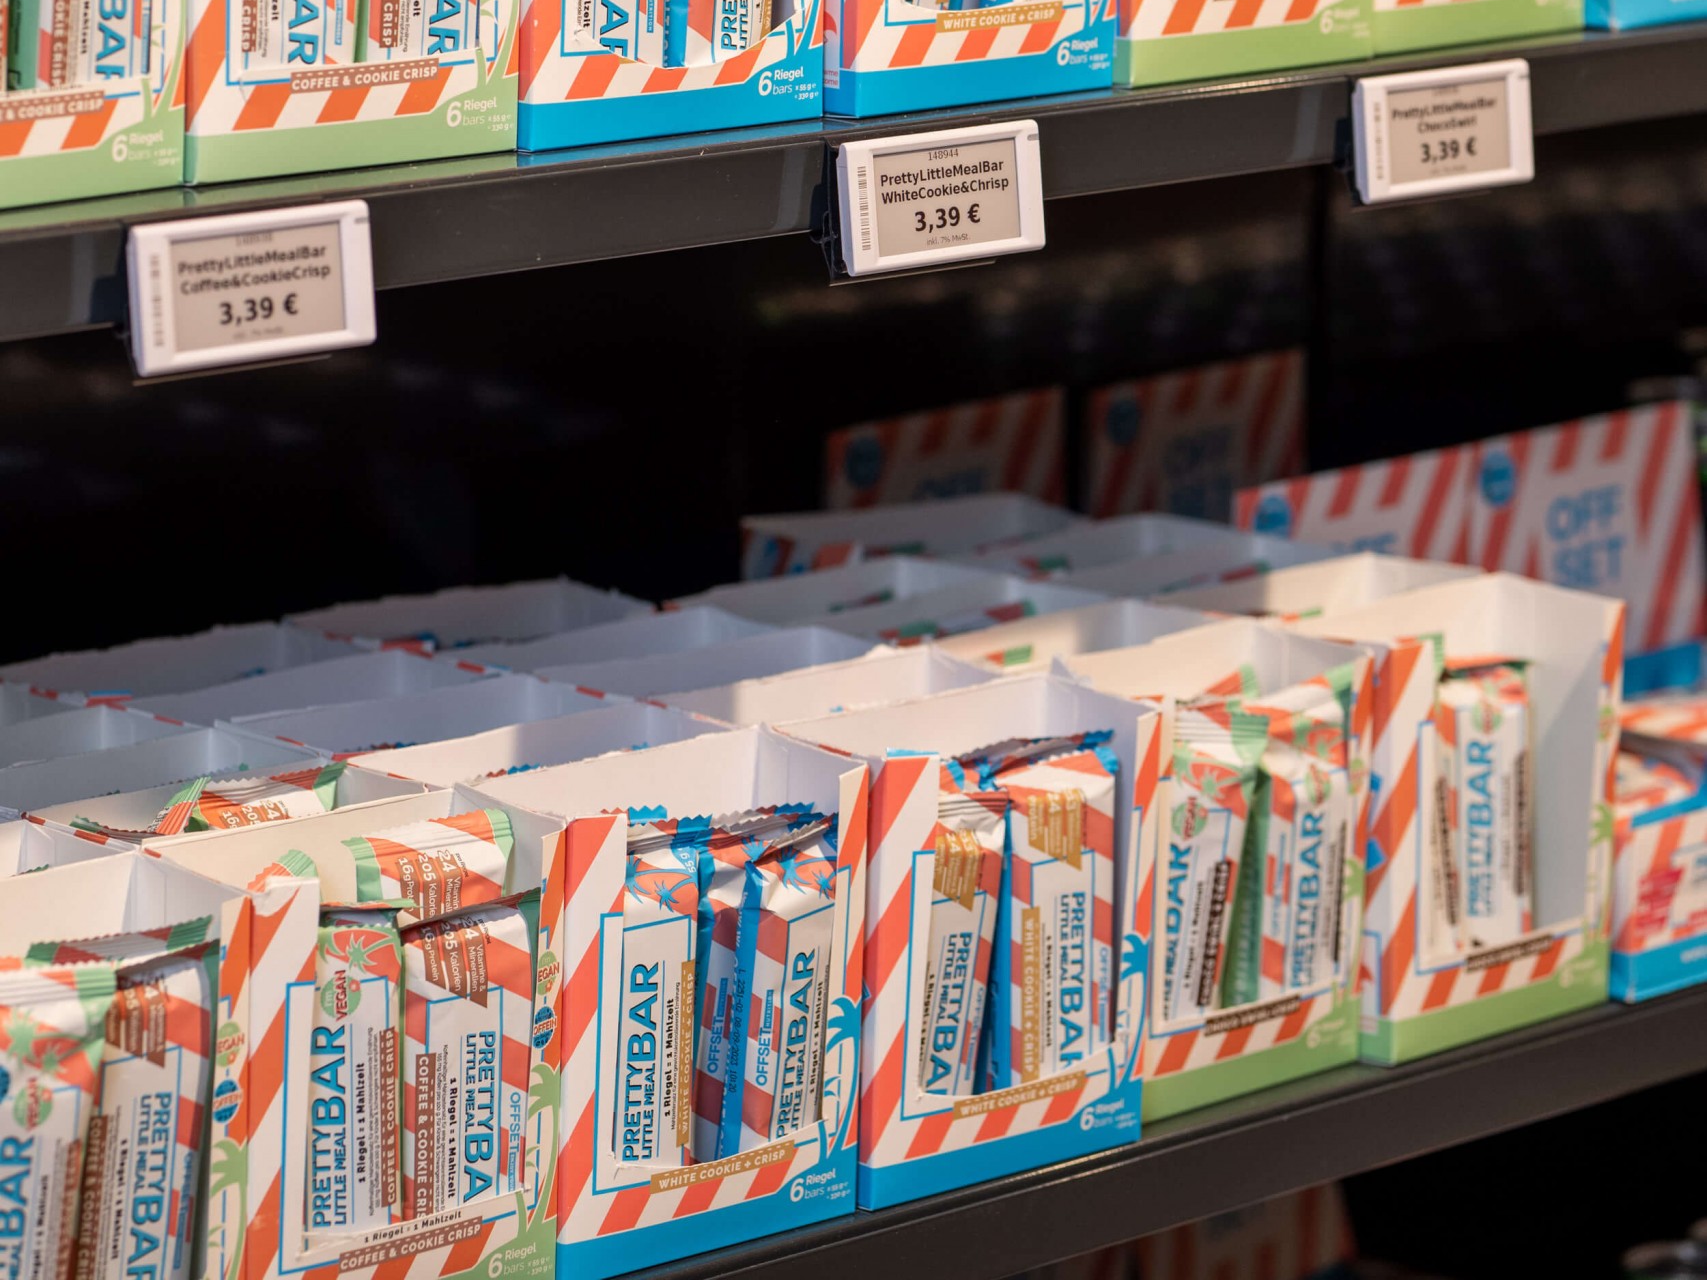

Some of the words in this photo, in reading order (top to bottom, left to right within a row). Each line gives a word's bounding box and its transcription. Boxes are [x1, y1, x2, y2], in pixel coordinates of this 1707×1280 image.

[241, 6, 252, 51] CRISP
[382, 3, 394, 46] CRISP
[740, 1, 750, 50] LITTLE
[943, 17, 977, 30] WHITE
[980, 14, 1017, 26] COOKIE
[1027, 8, 1055, 21] CRISP
[1057, 40, 1072, 66] 6
[292, 77, 339, 91] COFFEE
[343, 75, 351, 87] &
[355, 71, 400, 86] COOKIE
[403, 67, 438, 80] CRISP
[758, 71, 773, 96] 6
[774, 66, 804, 81] Riegel
[772, 82, 793, 95] bars
[18, 101, 65, 119] COOKIE
[67, 96, 104, 113] CRISP
[446, 102, 462, 127] 6
[463, 97, 497, 111] Riegel
[462, 114, 485, 126] bars
[112, 134, 128, 161] 6
[129, 129, 164, 147] Riegel
[928, 148, 960, 160] 148944
[1421, 138, 1459, 163] 3,39
[1466, 136, 1477, 156] €
[880, 160, 1004, 187] PrettyLittleMealBar
[881, 176, 1010, 205] WhiteCookie&Chrisp
[914, 205, 961, 233] 3,39
[967, 203, 981, 224] €
[178, 244, 327, 277] PrettyLittleMealBar
[179, 263, 331, 296] Coffee&CookieCrisp
[219, 296, 274, 326] 3,39
[284, 293, 298, 316] €
[418, 853, 437, 881] 205
[437, 850, 458, 873] 24
[428, 949, 439, 981] Protein
[441, 922, 458, 950] 205
[450, 951, 463, 992] Kalorien
[467, 946, 478, 992] Mineralien
[475, 944, 486, 982] Vitamine
[538, 961, 561, 983] EGAN
[943, 933, 958, 981] LITTLE
[335, 970, 347, 1022] VEGAN
[665, 999, 674, 1049] Mahlzeit
[386, 1029, 395, 1072] CRISP
[465, 1033, 477, 1085] LITTLE
[707, 1016, 725, 1074] OFFSET
[755, 1027, 772, 1086] OFFSET
[356, 1063, 365, 1115] Mahlzeit
[418, 1056, 429, 1110] COFFEE
[643, 1064, 656, 1104] MEAL
[664, 1070, 673, 1108] Riegel
[960, 1101, 995, 1116] WHITE
[1000, 1091, 1037, 1108] COOKIE
[1048, 1081, 1077, 1096] CRISP
[137, 1095, 151, 1146] LITTLE
[386, 1085, 395, 1131] COOKIE
[447, 1088, 458, 1126] Riegel
[464, 1089, 475, 1133] MEAL
[509, 1091, 521, 1152] OFFSET
[1080, 1107, 1095, 1131] 6
[334, 1128, 347, 1170] MEAL
[641, 1108, 654, 1160] LITTLE
[357, 1137, 367, 1176] Riegel
[417, 1130, 428, 1183] COOKIE
[447, 1147, 457, 1198] Mahlzeit
[658, 1173, 697, 1190] WHITE
[700, 1161, 741, 1179] COOKIE
[754, 1149, 786, 1167] CRISP
[334, 1175, 347, 1225] LITTLE
[387, 1158, 396, 1204] COFFEE
[790, 1178, 804, 1202] 6
[806, 1168, 836, 1186] Riegel
[804, 1187, 824, 1200] bars
[373, 1226, 404, 1242] Riegel
[421, 1211, 462, 1229] Mahlzeit
[341, 1253, 385, 1270] COFFEE
[389, 1247, 398, 1258] &
[401, 1237, 445, 1255] COOKIE
[448, 1226, 480, 1242] CRISP
[488, 1252, 502, 1278] 6
[504, 1242, 537, 1262] Riegel
[503, 1263, 525, 1277] bars
